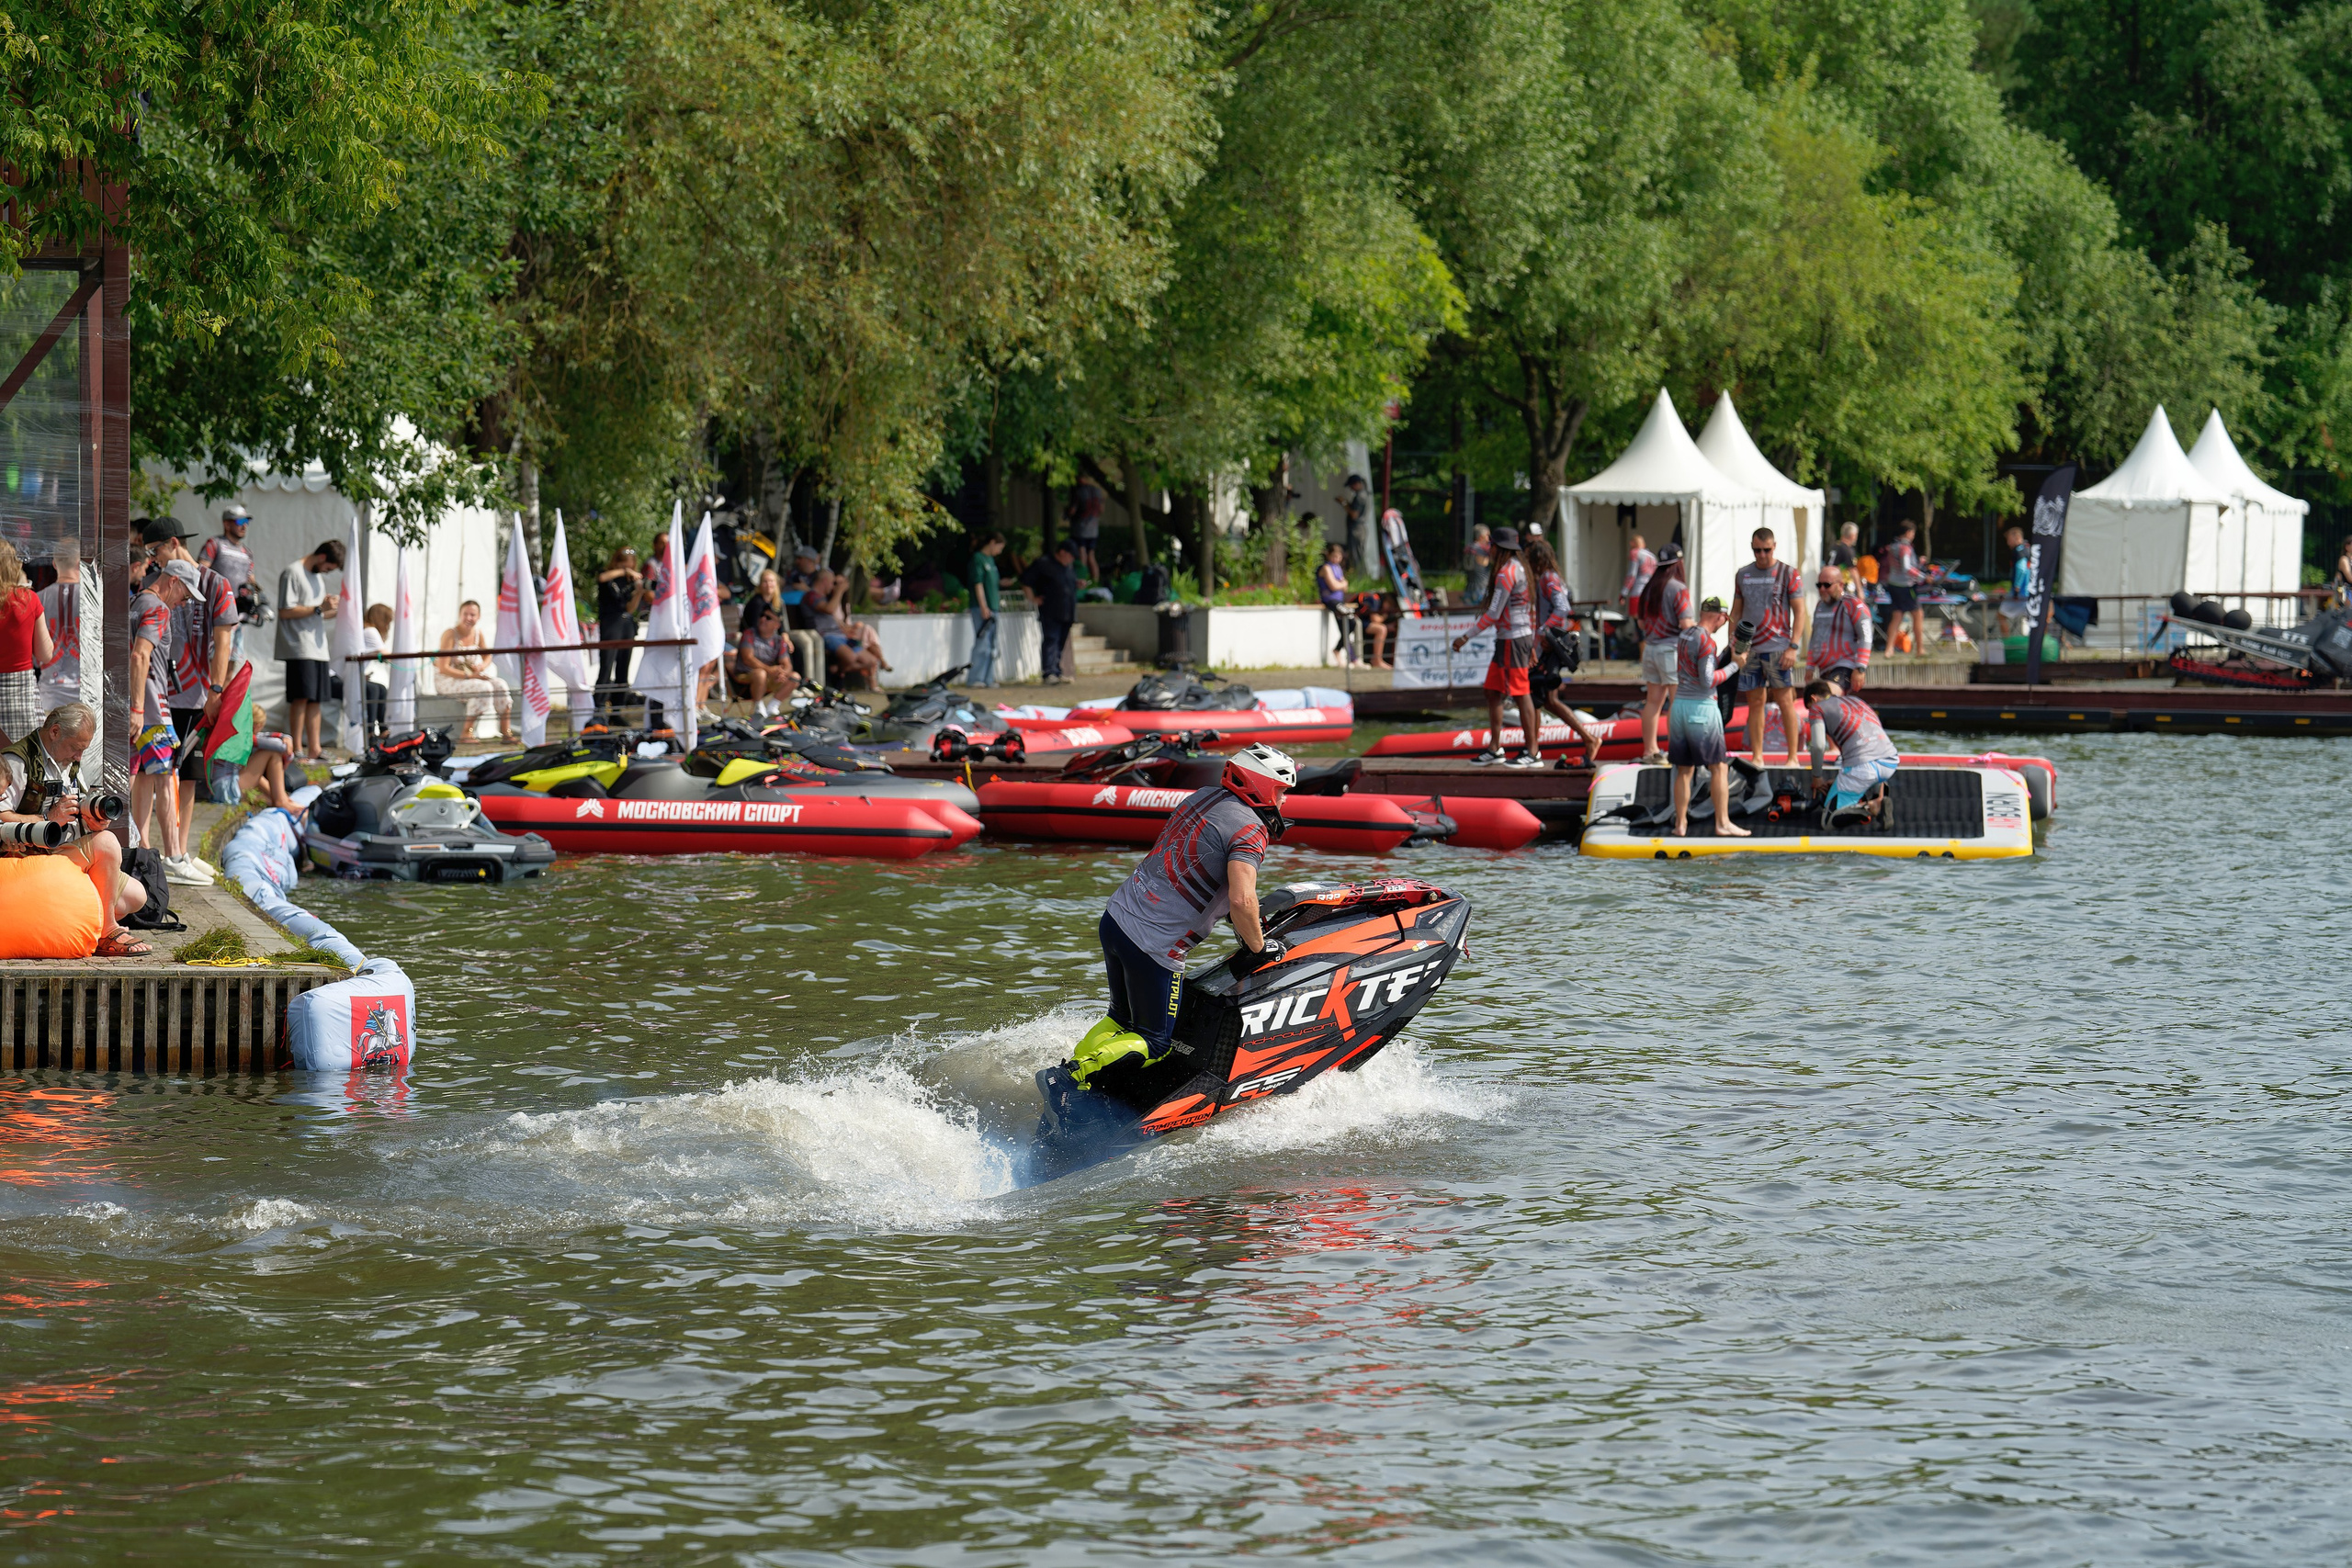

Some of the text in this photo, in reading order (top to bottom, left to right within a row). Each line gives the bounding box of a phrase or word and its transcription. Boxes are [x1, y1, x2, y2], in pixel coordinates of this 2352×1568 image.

[1420, 667, 1478, 683] freetyle
[617, 801, 804, 823] МОСКОВСКИЙ СПОРТ
[1316, 893, 1340, 901] RRP
[1167, 972, 1182, 1018] ETPILOT
[1144, 1111, 1212, 1133] COMPETITION
